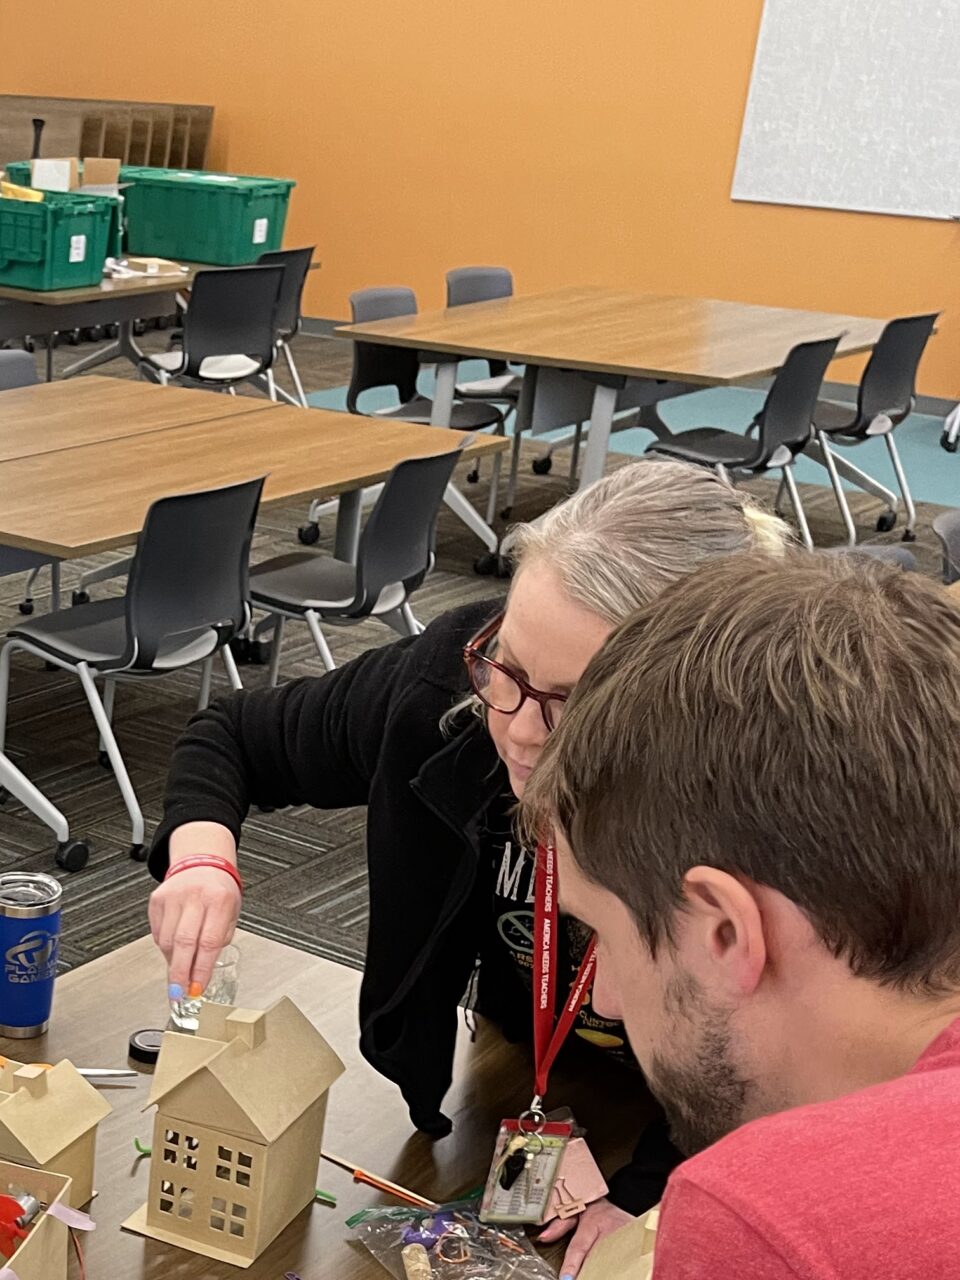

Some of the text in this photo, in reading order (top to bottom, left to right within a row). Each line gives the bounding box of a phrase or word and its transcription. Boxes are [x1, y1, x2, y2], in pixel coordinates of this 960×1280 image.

[540, 919, 552, 1009] AMERICA NEEDS TEACHERS
